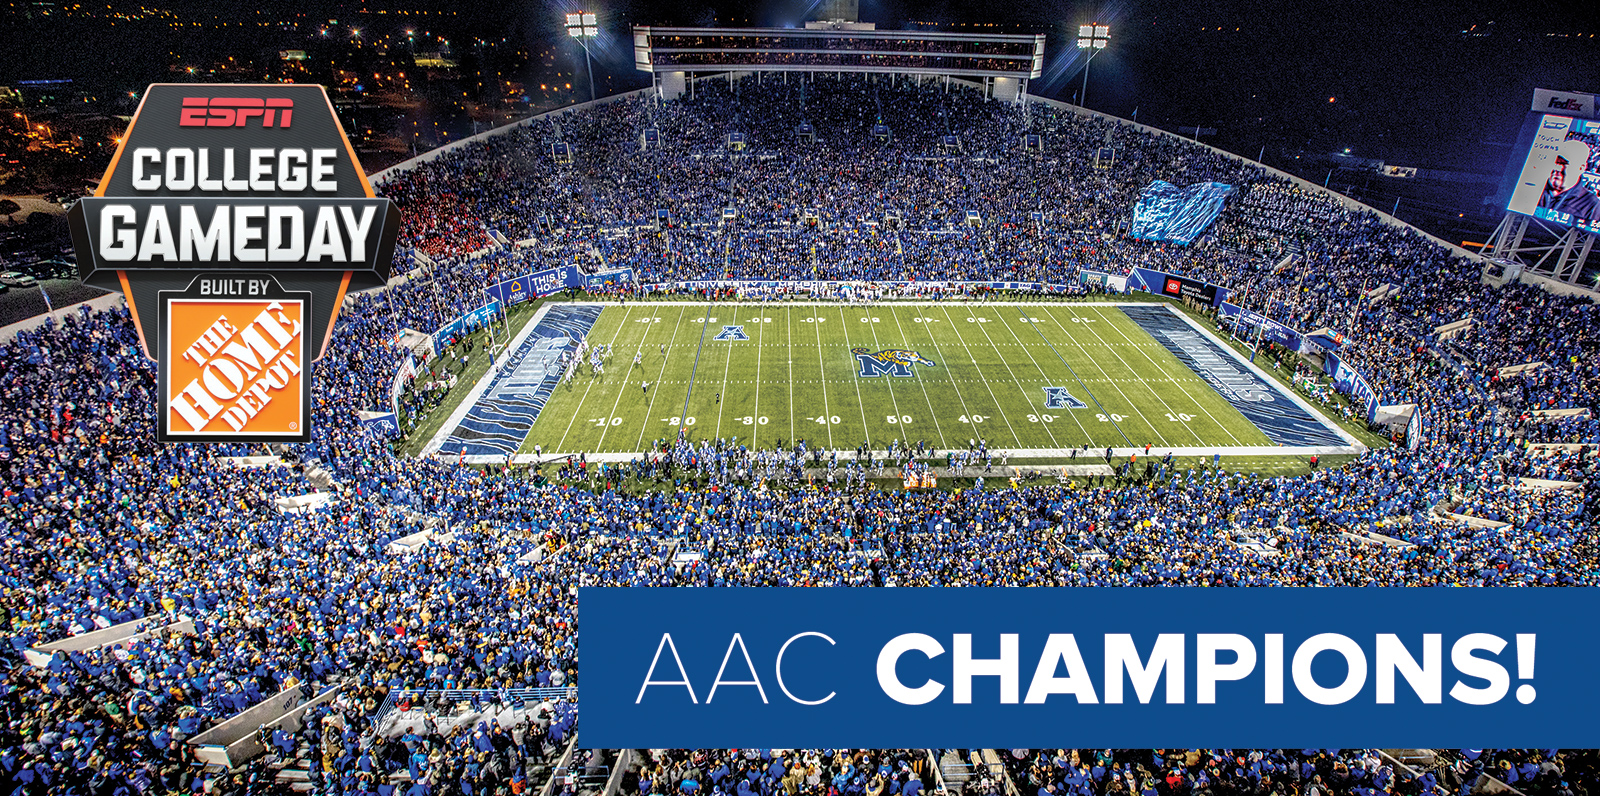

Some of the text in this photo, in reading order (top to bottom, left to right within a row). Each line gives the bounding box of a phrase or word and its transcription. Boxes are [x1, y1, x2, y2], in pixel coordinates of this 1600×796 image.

[1548, 96, 1583, 111] FedEx
[531, 273, 556, 286] THIS
[283, 696, 293, 711] 107
